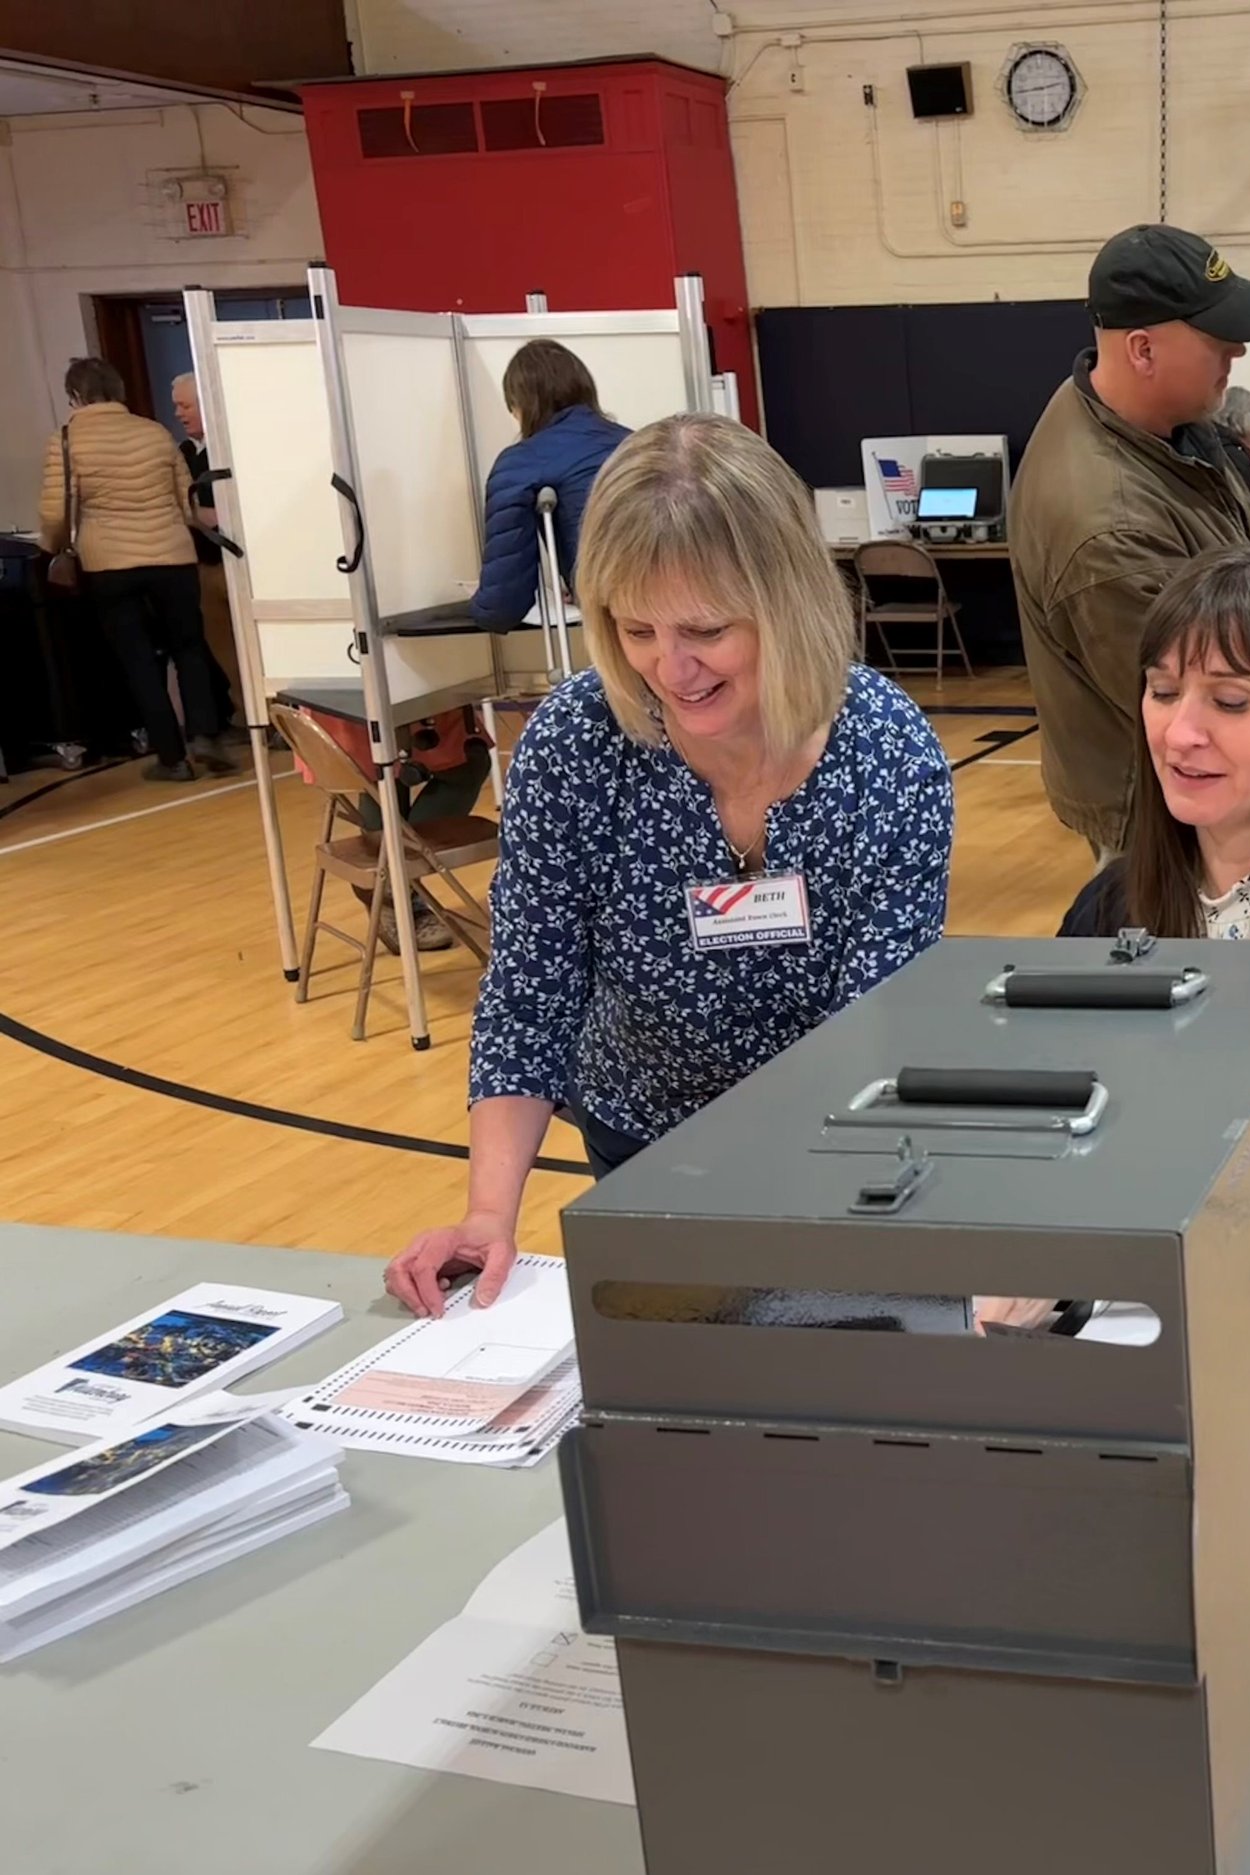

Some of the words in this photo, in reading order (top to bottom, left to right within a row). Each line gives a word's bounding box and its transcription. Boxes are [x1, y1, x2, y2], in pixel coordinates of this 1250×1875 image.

[186, 203, 220, 232] EXIT
[896, 499, 919, 515] VOT
[754, 891, 785, 903] BETH
[700, 932, 753, 946] ELECTION
[756, 928, 805, 940] OFFICIAL
